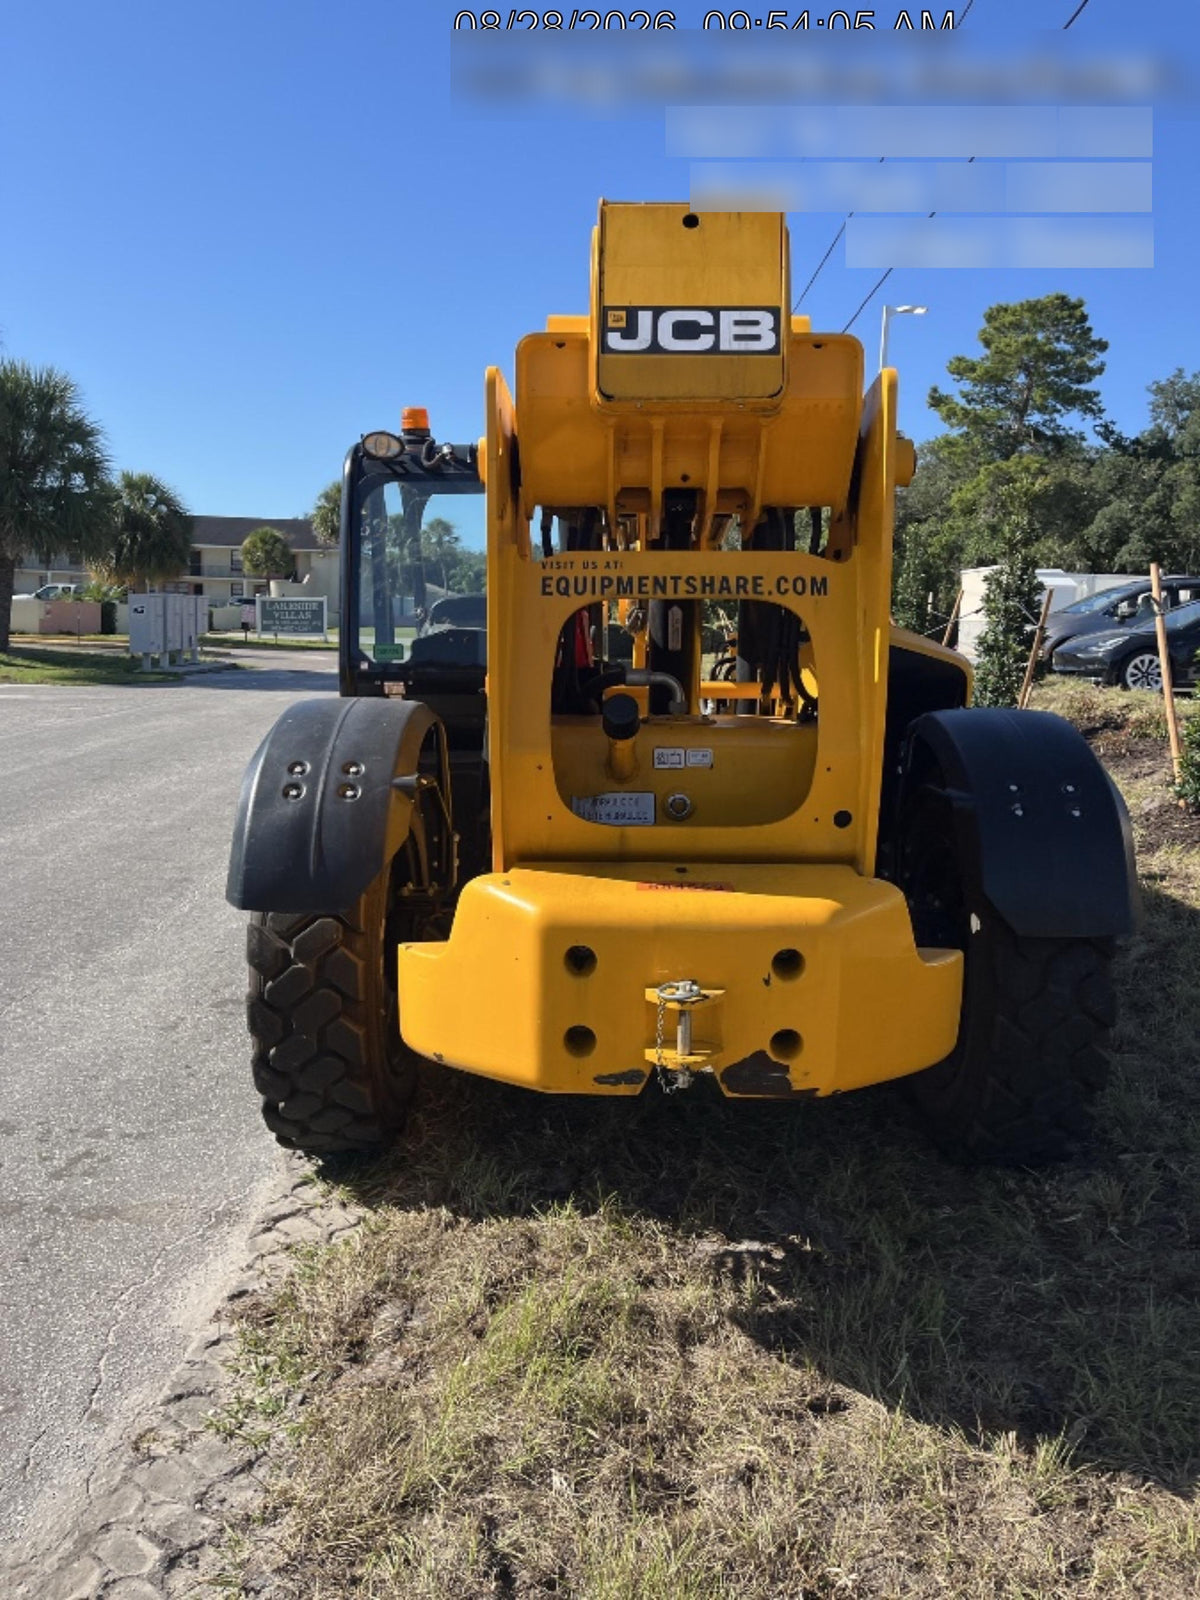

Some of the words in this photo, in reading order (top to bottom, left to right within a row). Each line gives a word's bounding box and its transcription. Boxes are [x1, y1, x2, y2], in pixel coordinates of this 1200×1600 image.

[607, 310, 776, 351] JCB
[541, 561, 574, 569] VISIT
[583, 561, 598, 569] US
[541, 576, 828, 597] EQUIPMENTSHARE.COM
